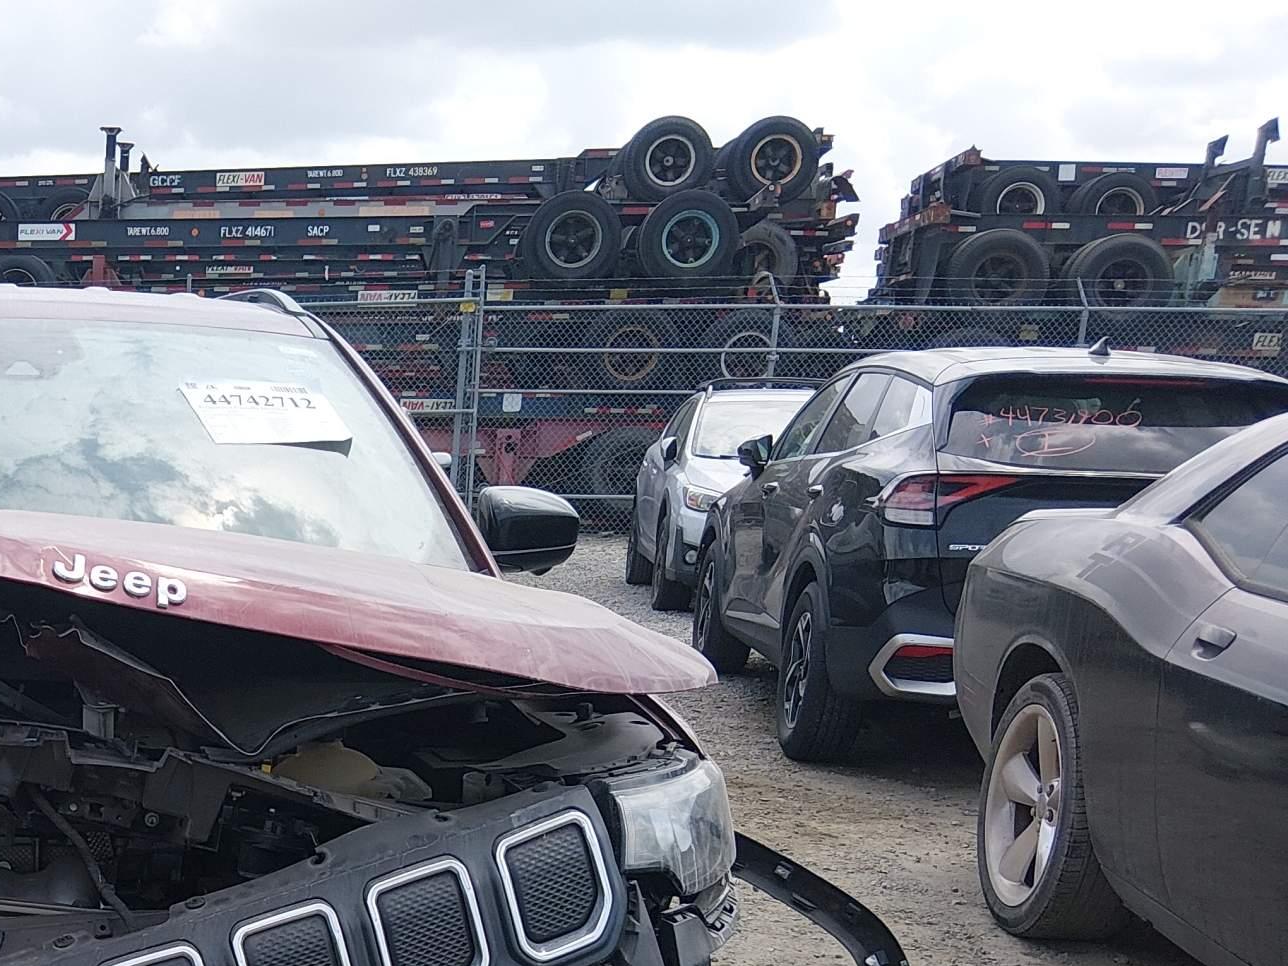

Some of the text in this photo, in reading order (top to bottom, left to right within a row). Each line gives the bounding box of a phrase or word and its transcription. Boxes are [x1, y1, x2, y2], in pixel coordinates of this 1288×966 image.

[386, 167, 438, 177] FLXZ 438369
[217, 173, 263, 185] FLEXI-VAN
[220, 225, 275, 238] FLXZ 414671
[307, 225, 330, 237] SACP
[203, 393, 317, 410] 44742712
[52, 553, 187, 609] Jeep
